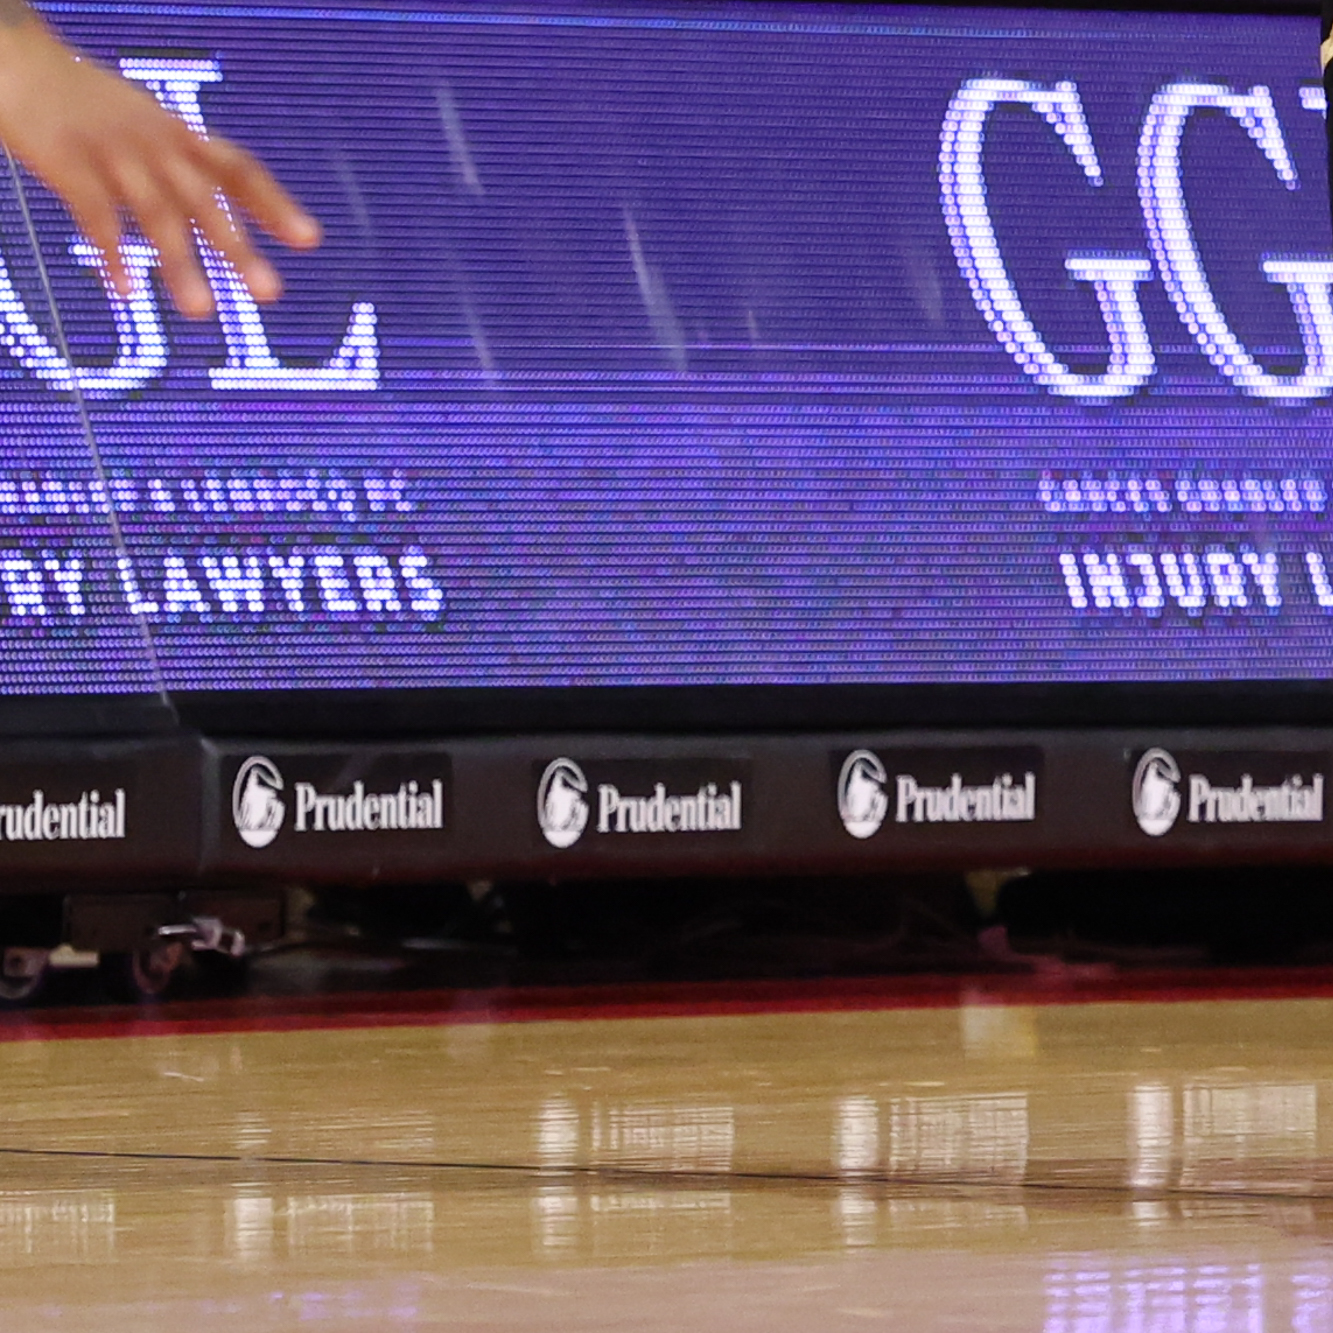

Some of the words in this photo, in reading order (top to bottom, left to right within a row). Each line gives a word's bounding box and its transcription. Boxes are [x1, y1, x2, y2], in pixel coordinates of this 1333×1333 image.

[117, 550, 442, 614] LAWYERS
[1059, 552, 1282, 609] INJURY
[294, 779, 443, 832] Prudential
[597, 780, 742, 834] Prudential
[895, 773, 1035, 825] Prudential
[1189, 772, 1324, 822] Prudential
